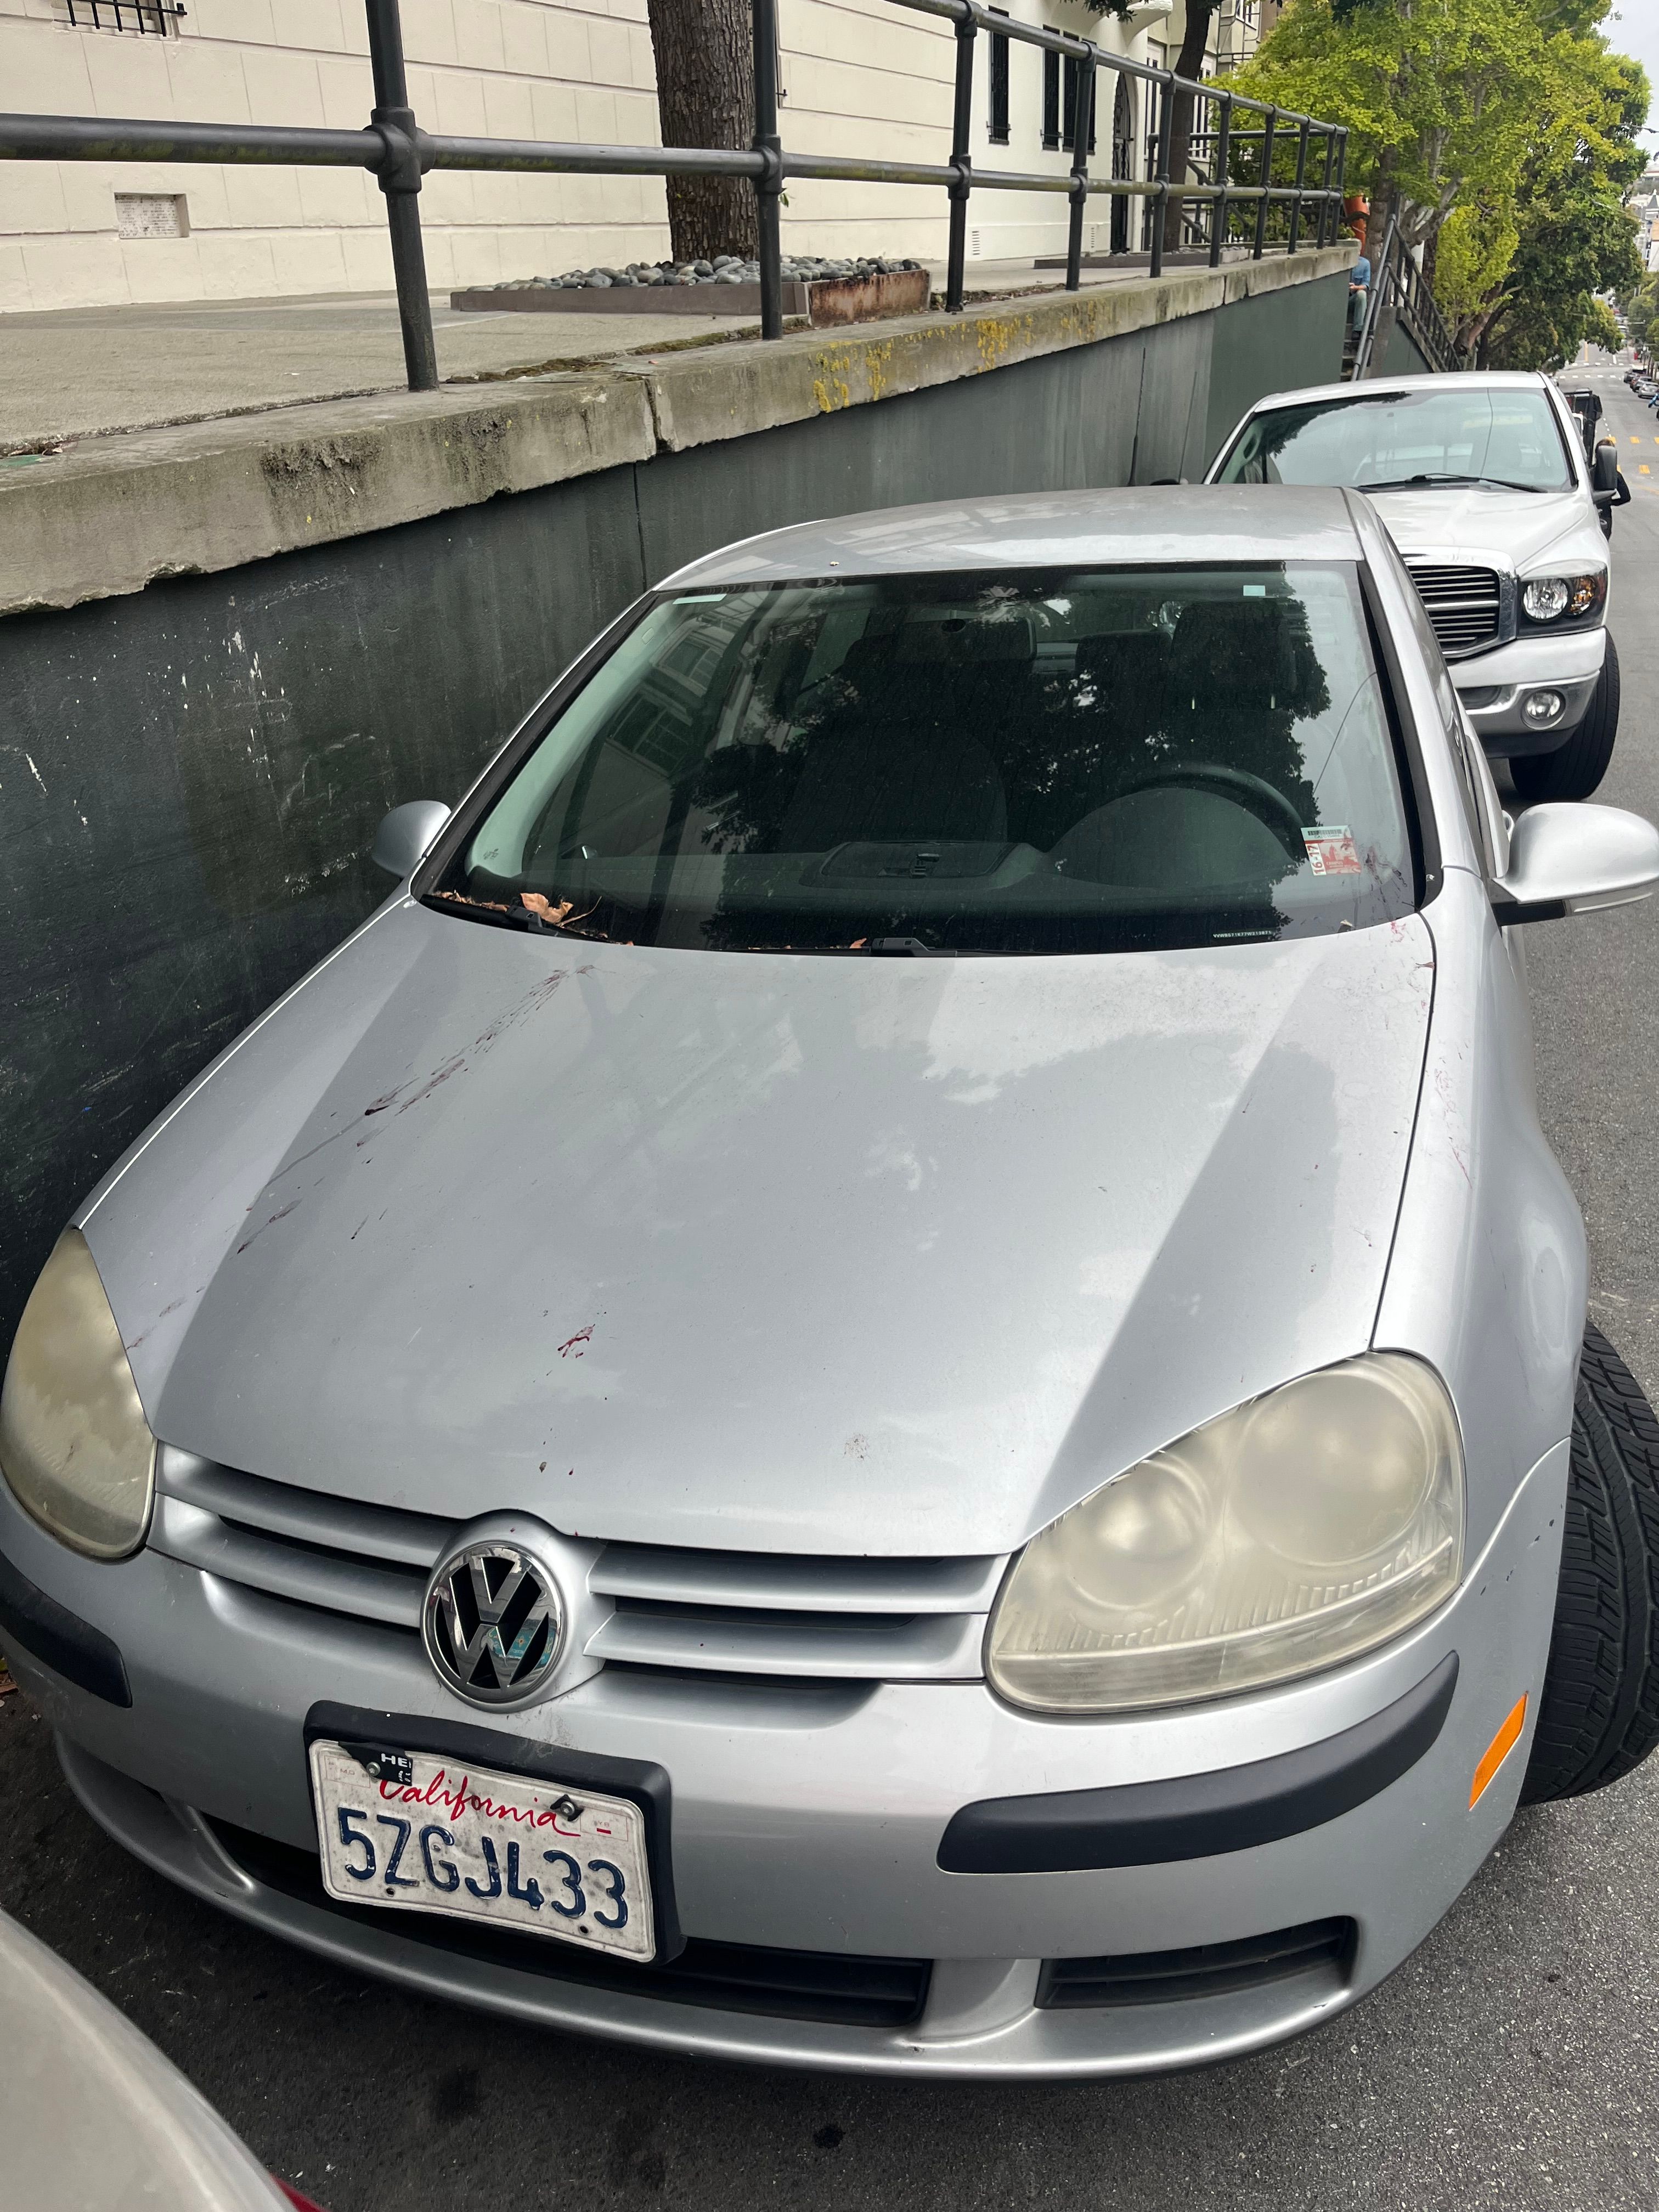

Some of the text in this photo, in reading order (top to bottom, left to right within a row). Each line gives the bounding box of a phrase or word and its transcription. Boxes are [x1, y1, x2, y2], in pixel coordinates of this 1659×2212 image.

[381, 1753, 411, 1769] HE
[379, 1770, 582, 1837] California
[337, 1807, 629, 1930] 5ZGJ433
